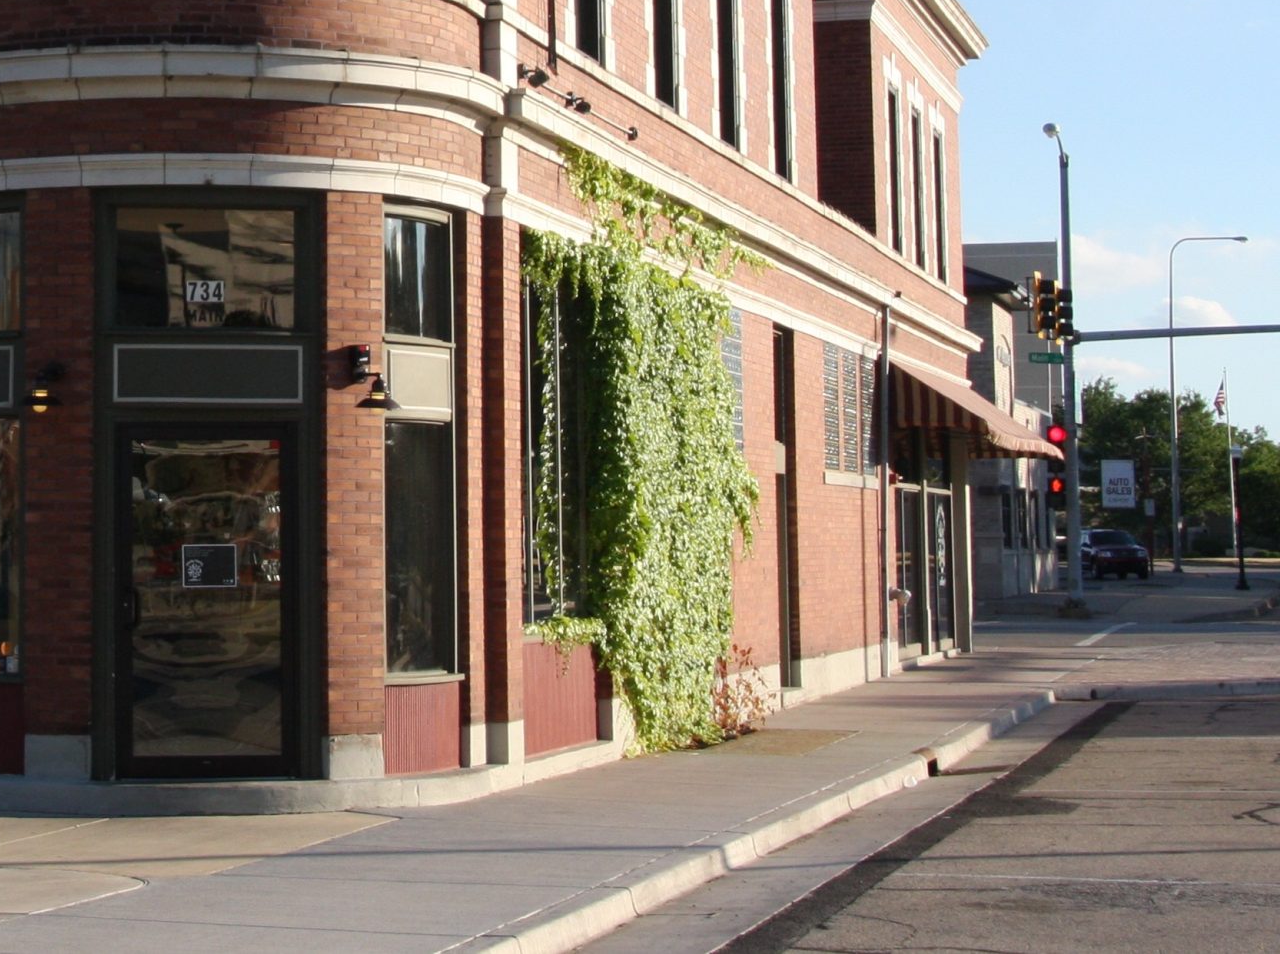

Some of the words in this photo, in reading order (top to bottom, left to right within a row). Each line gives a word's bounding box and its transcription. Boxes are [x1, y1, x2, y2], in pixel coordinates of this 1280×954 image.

[188, 281, 222, 301] 734
[1108, 477, 1130, 486] AUTO
[1106, 486, 1132, 495] SALES
